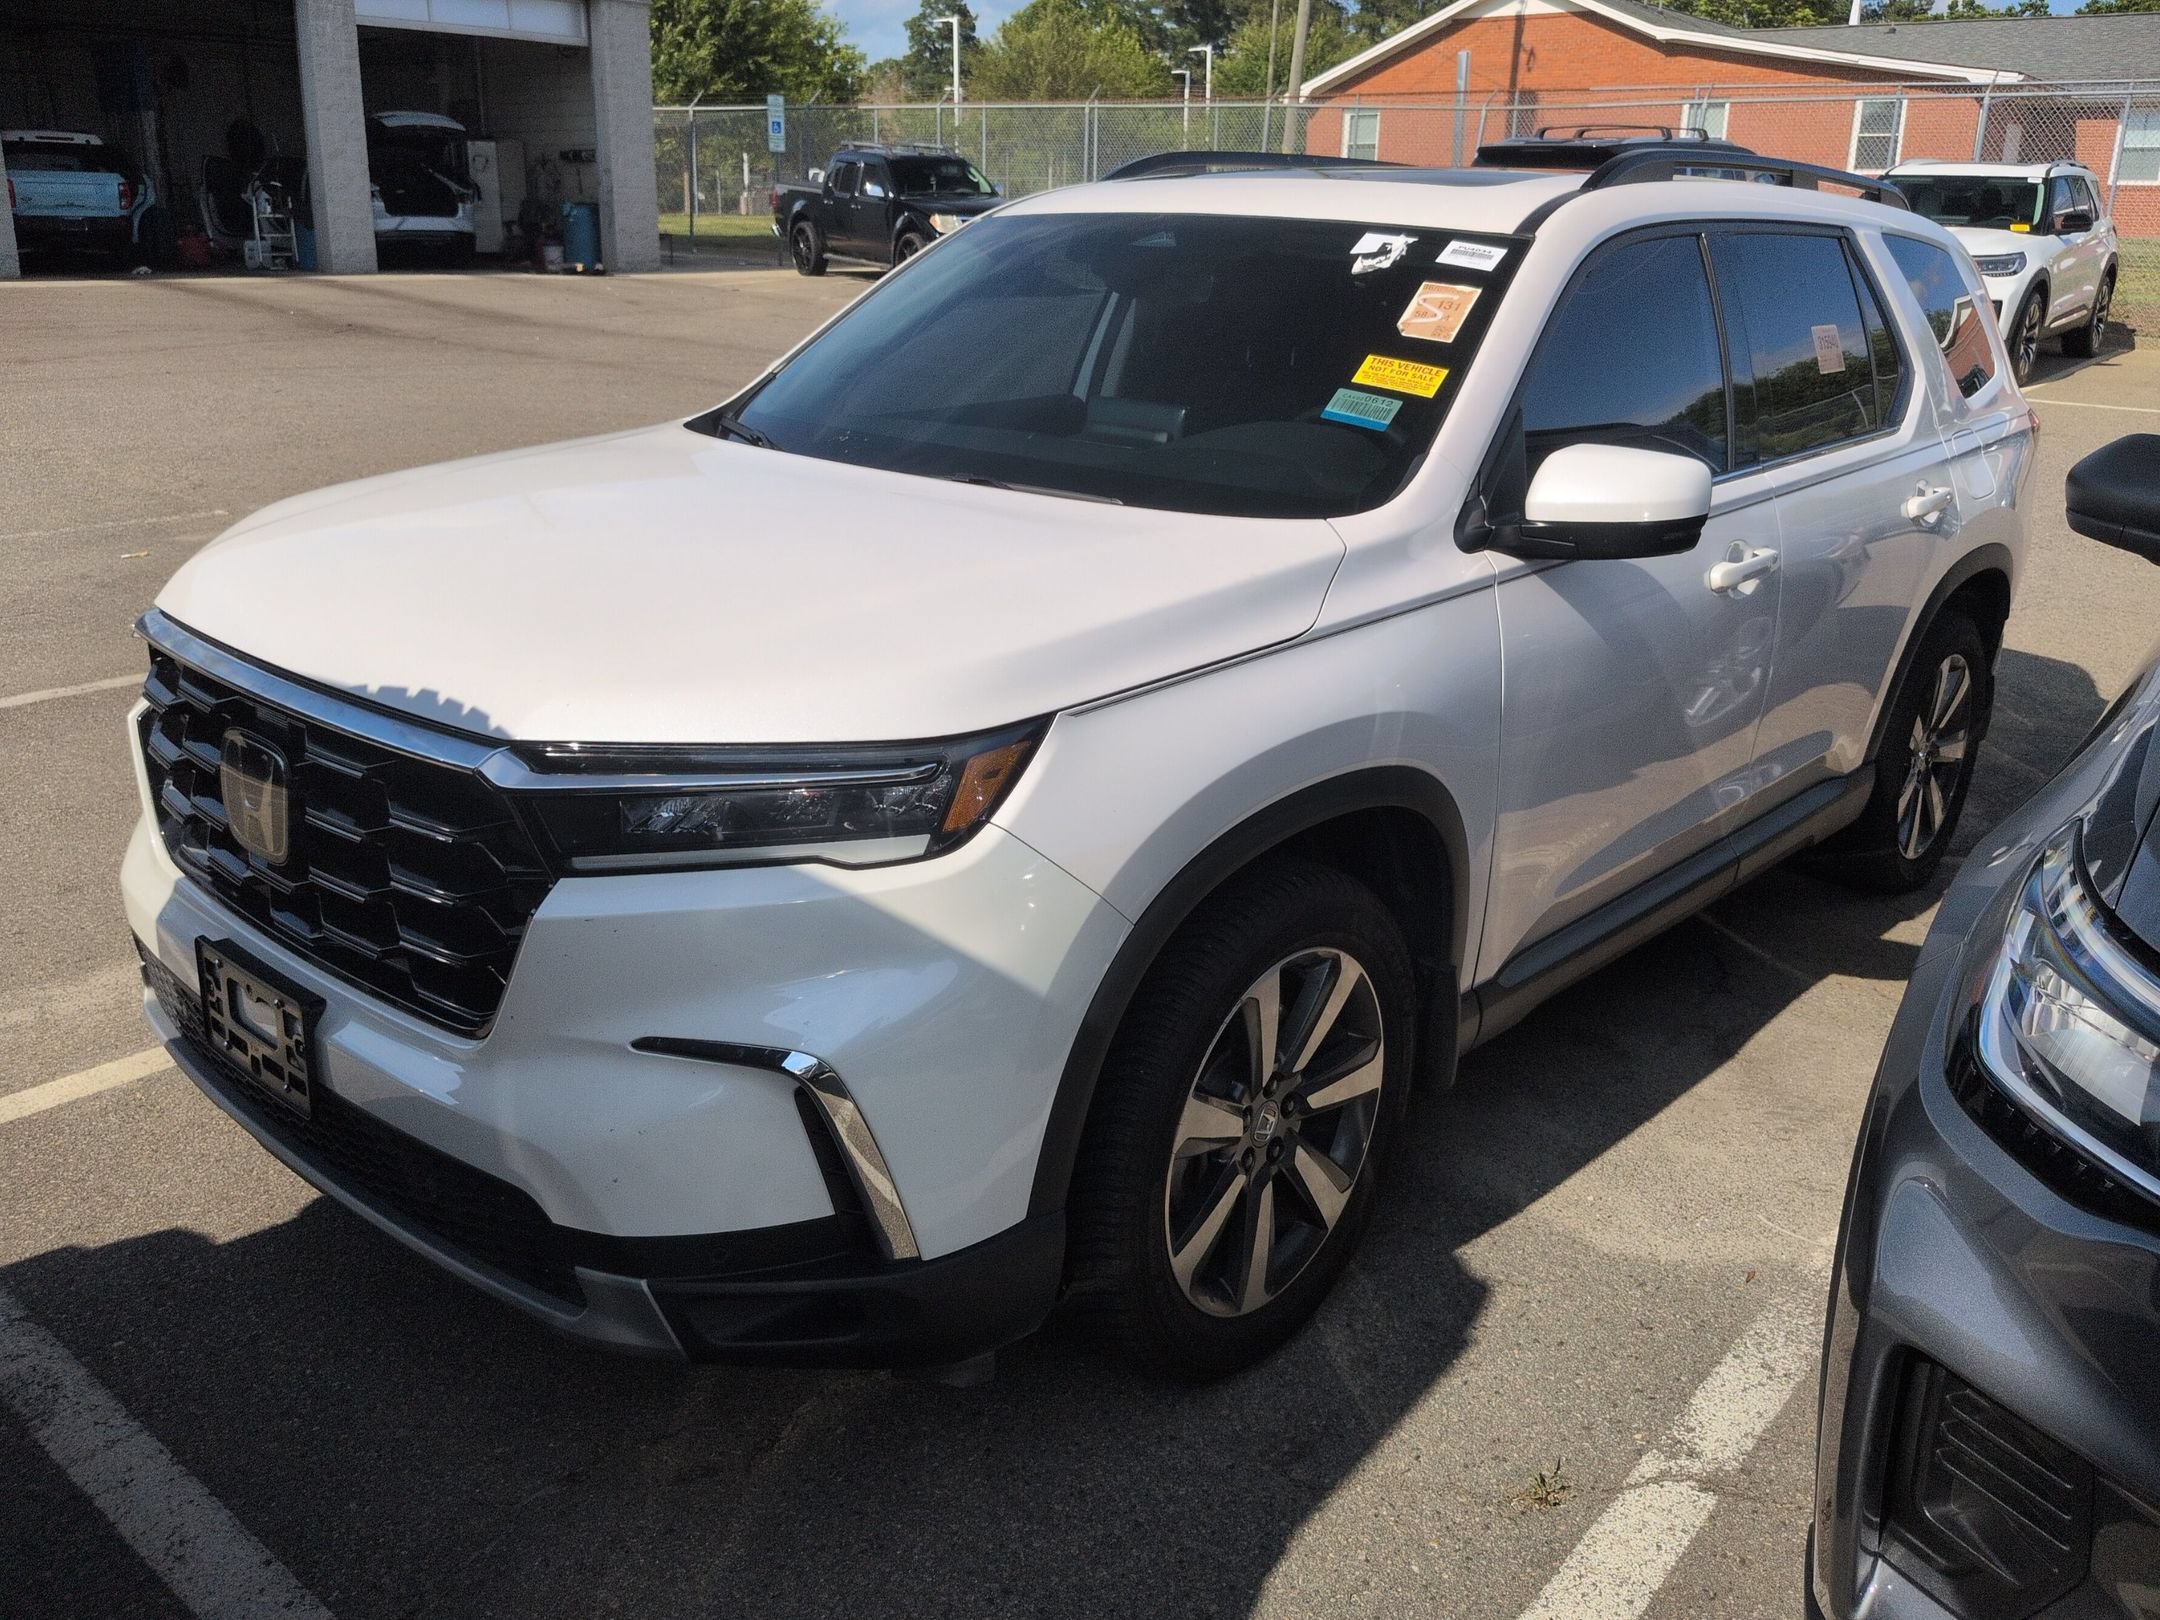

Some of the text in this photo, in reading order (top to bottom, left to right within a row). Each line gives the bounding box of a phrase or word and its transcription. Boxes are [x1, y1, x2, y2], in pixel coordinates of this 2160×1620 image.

[1368, 365, 1387, 373] NOT
[1390, 368, 1409, 377] FOR
[1412, 373, 1436, 382] SALE
[1371, 357, 1443, 377] THIS VEHICLE
